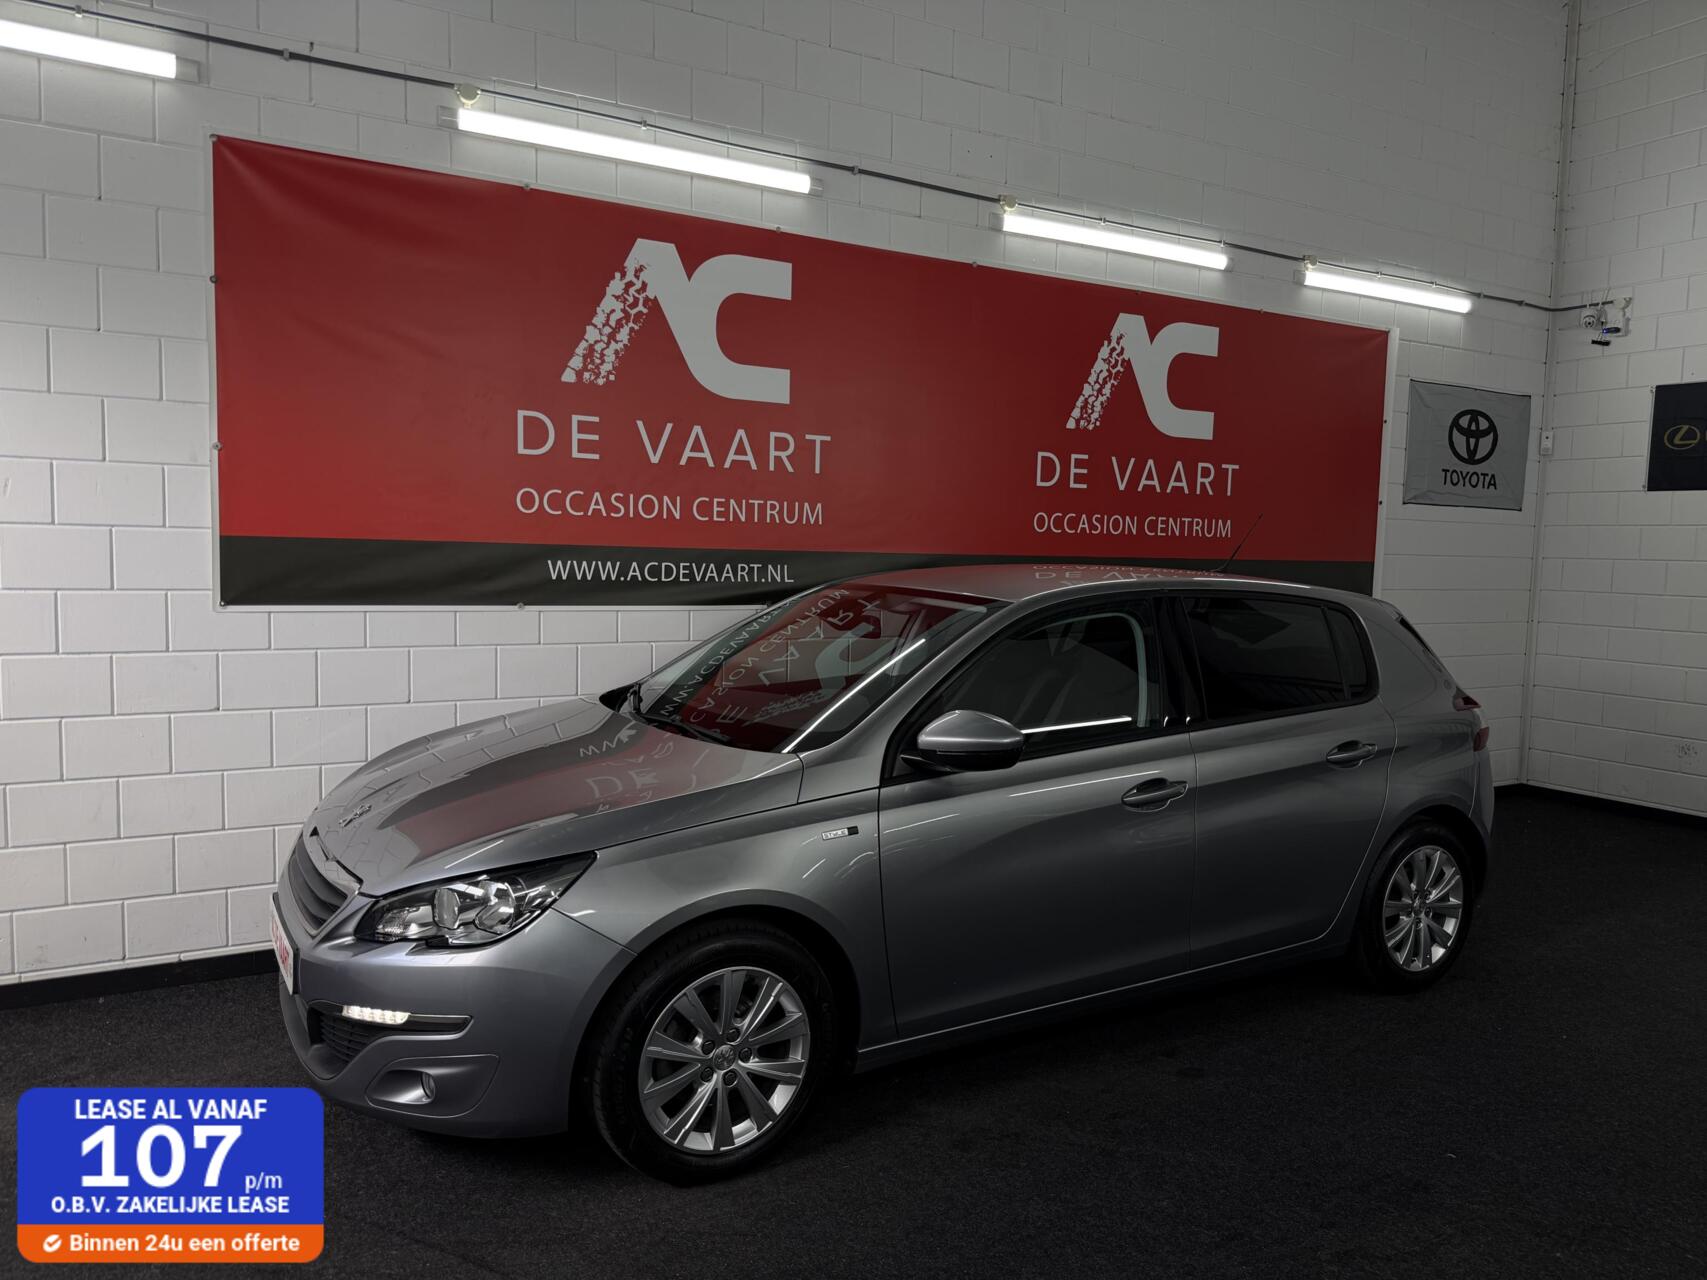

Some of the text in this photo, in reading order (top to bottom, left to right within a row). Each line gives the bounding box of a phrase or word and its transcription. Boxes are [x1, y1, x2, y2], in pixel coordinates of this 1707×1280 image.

[561, 238, 793, 405] AC
[1066, 312, 1220, 441] AC
[517, 409, 832, 474] DE VAART
[1036, 451, 1240, 497] DE VAART
[1442, 468, 1497, 490] TOYOTA
[516, 487, 823, 525] OCCASION CENTRUM
[1033, 512, 1232, 538] OCCASION CENTRUM
[548, 559, 794, 583] WWW.ACDEVAART.NL
